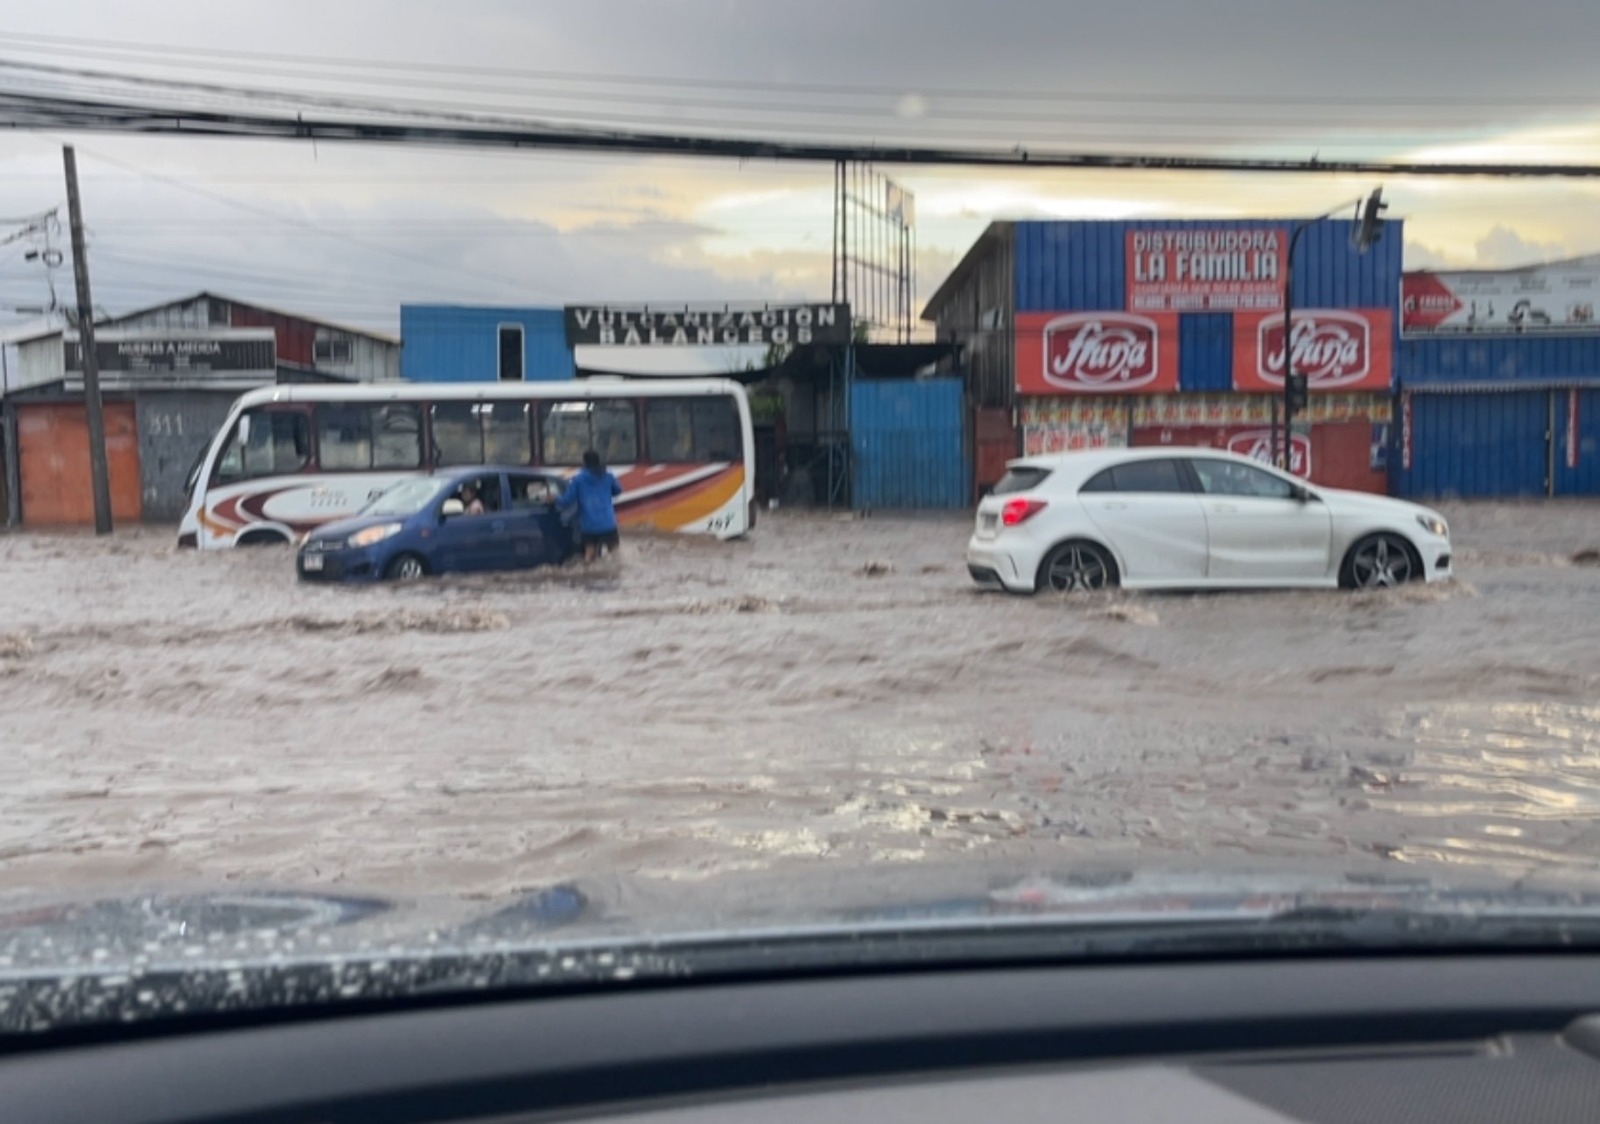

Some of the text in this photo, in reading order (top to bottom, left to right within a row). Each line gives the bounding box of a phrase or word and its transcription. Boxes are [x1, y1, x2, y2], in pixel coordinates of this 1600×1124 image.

[1134, 231, 1278, 251] DISTRIBUIDORA
[1134, 251, 1278, 281] LA FAMILIA
[600, 325, 813, 345] BALANCEOS
[166, 341, 176, 354] A
